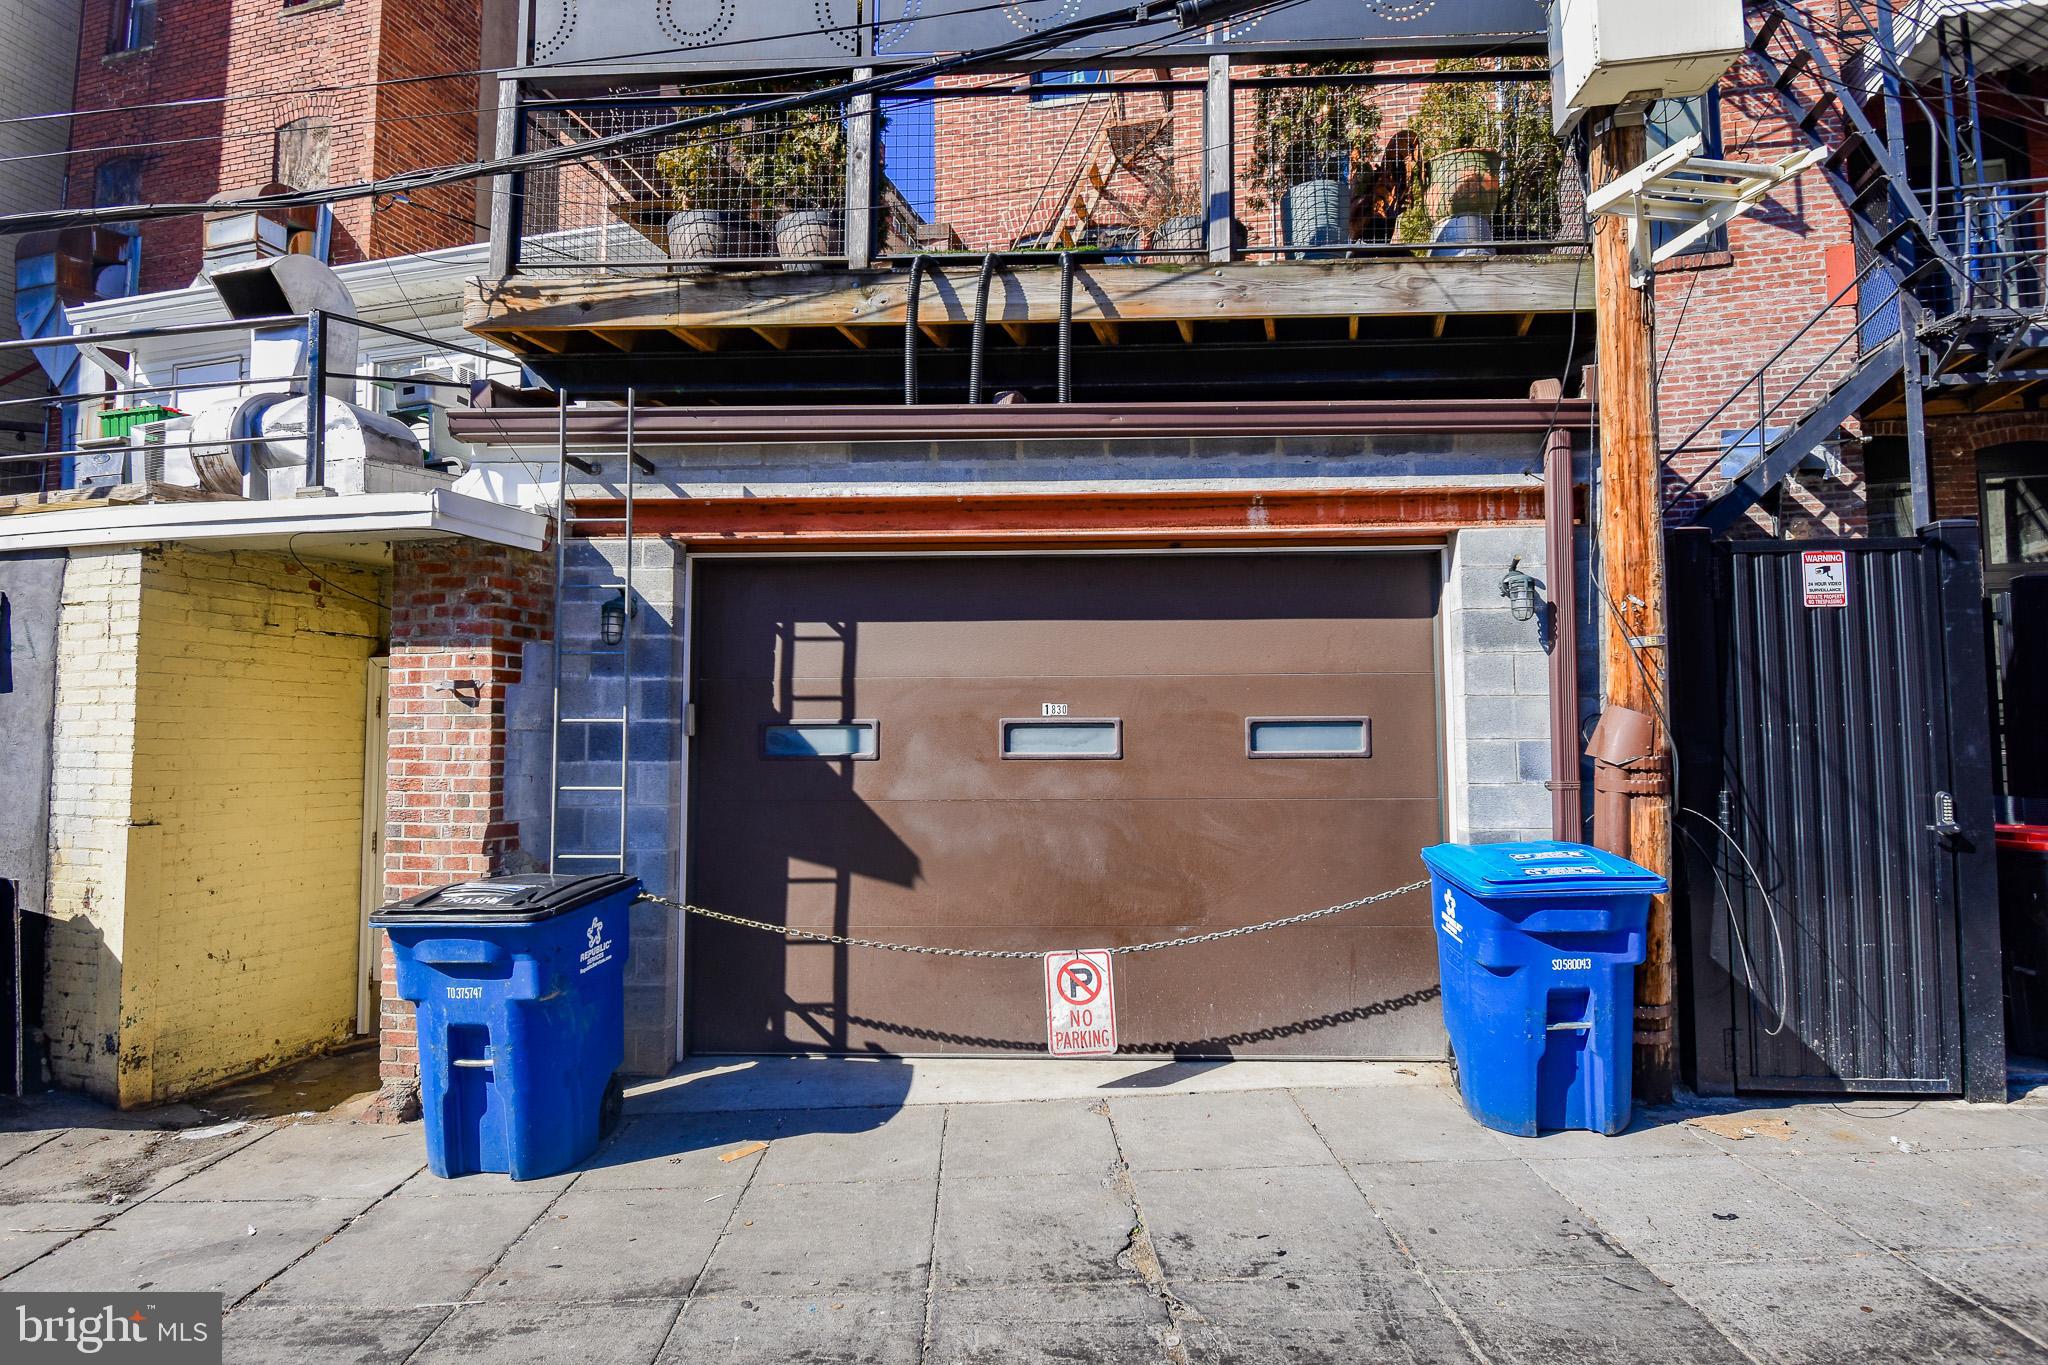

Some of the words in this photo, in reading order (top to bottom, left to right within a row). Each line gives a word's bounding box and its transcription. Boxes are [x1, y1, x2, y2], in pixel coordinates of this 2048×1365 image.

[1805, 554, 1842, 562] WARNING
[1044, 704, 1067, 715] 1830
[580, 941, 610, 962] REPUBLIC
[1069, 1009, 1093, 1027] NO
[1055, 1029, 1109, 1050] PARKING
